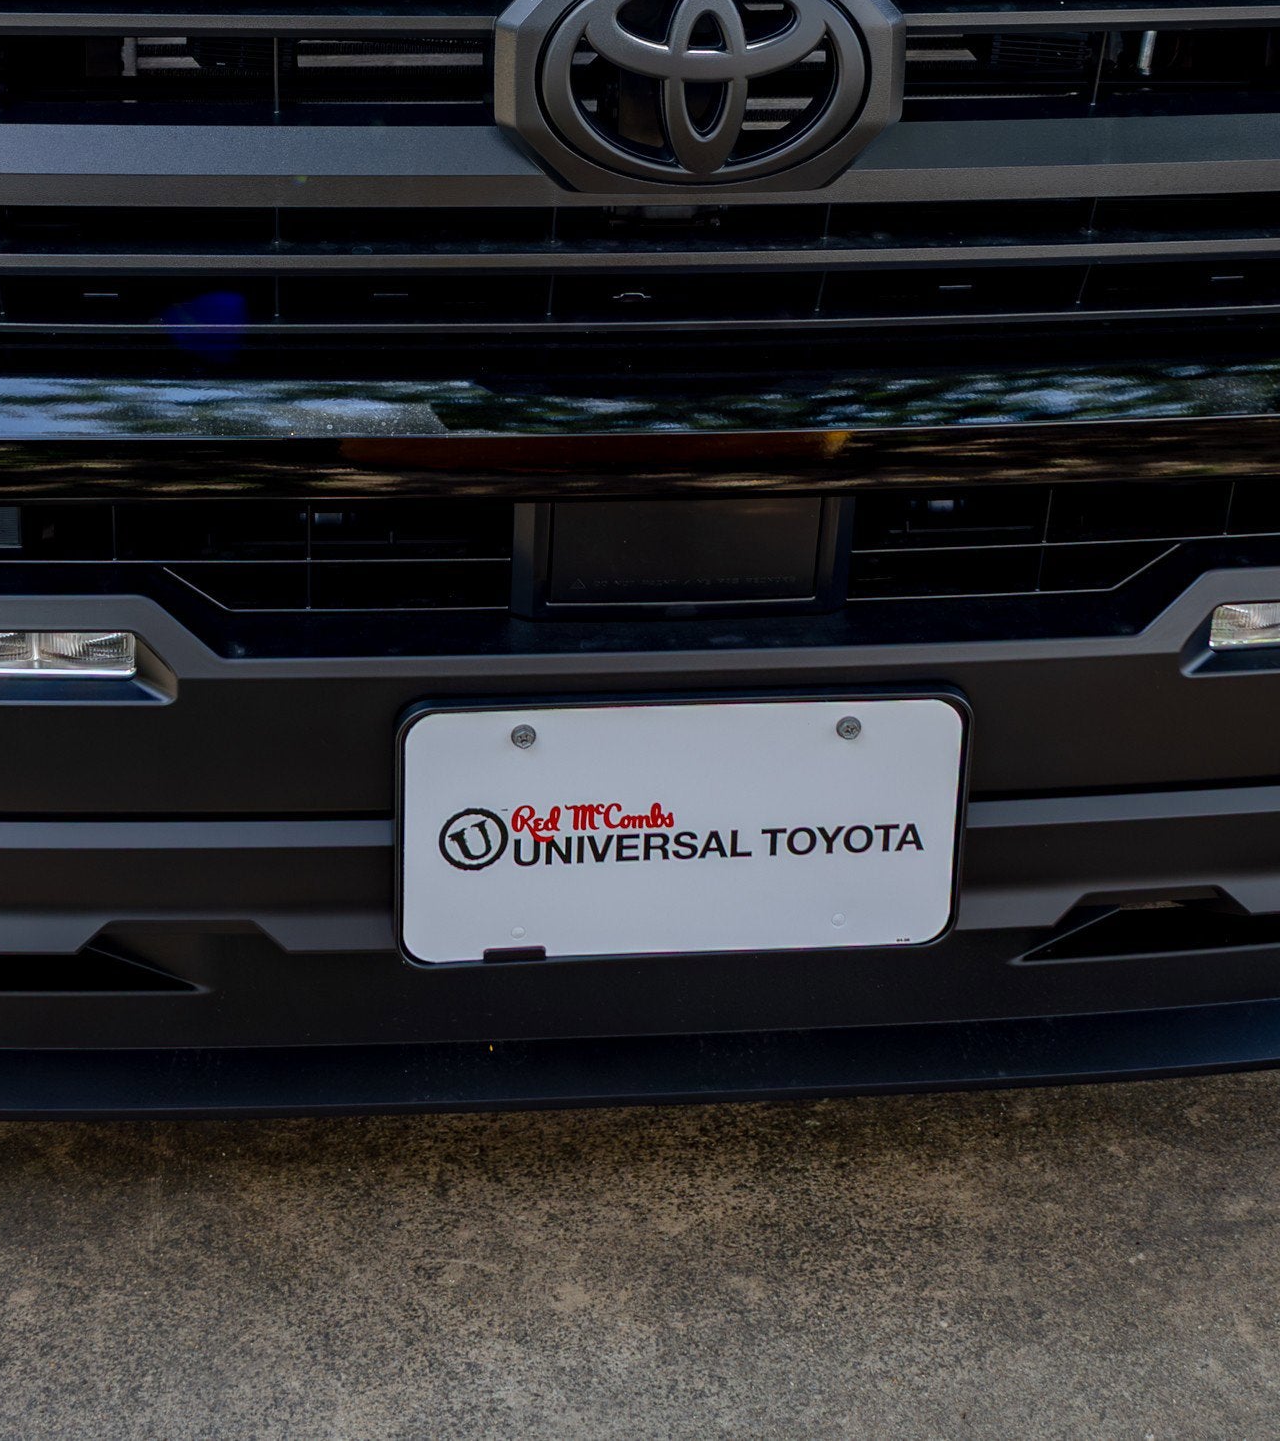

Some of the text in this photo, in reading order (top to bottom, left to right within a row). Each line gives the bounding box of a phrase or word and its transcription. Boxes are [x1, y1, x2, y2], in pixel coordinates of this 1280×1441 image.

[511, 802, 675, 843] Red McCombs
[514, 823, 926, 867] UNIVERSAL TOYOTA
